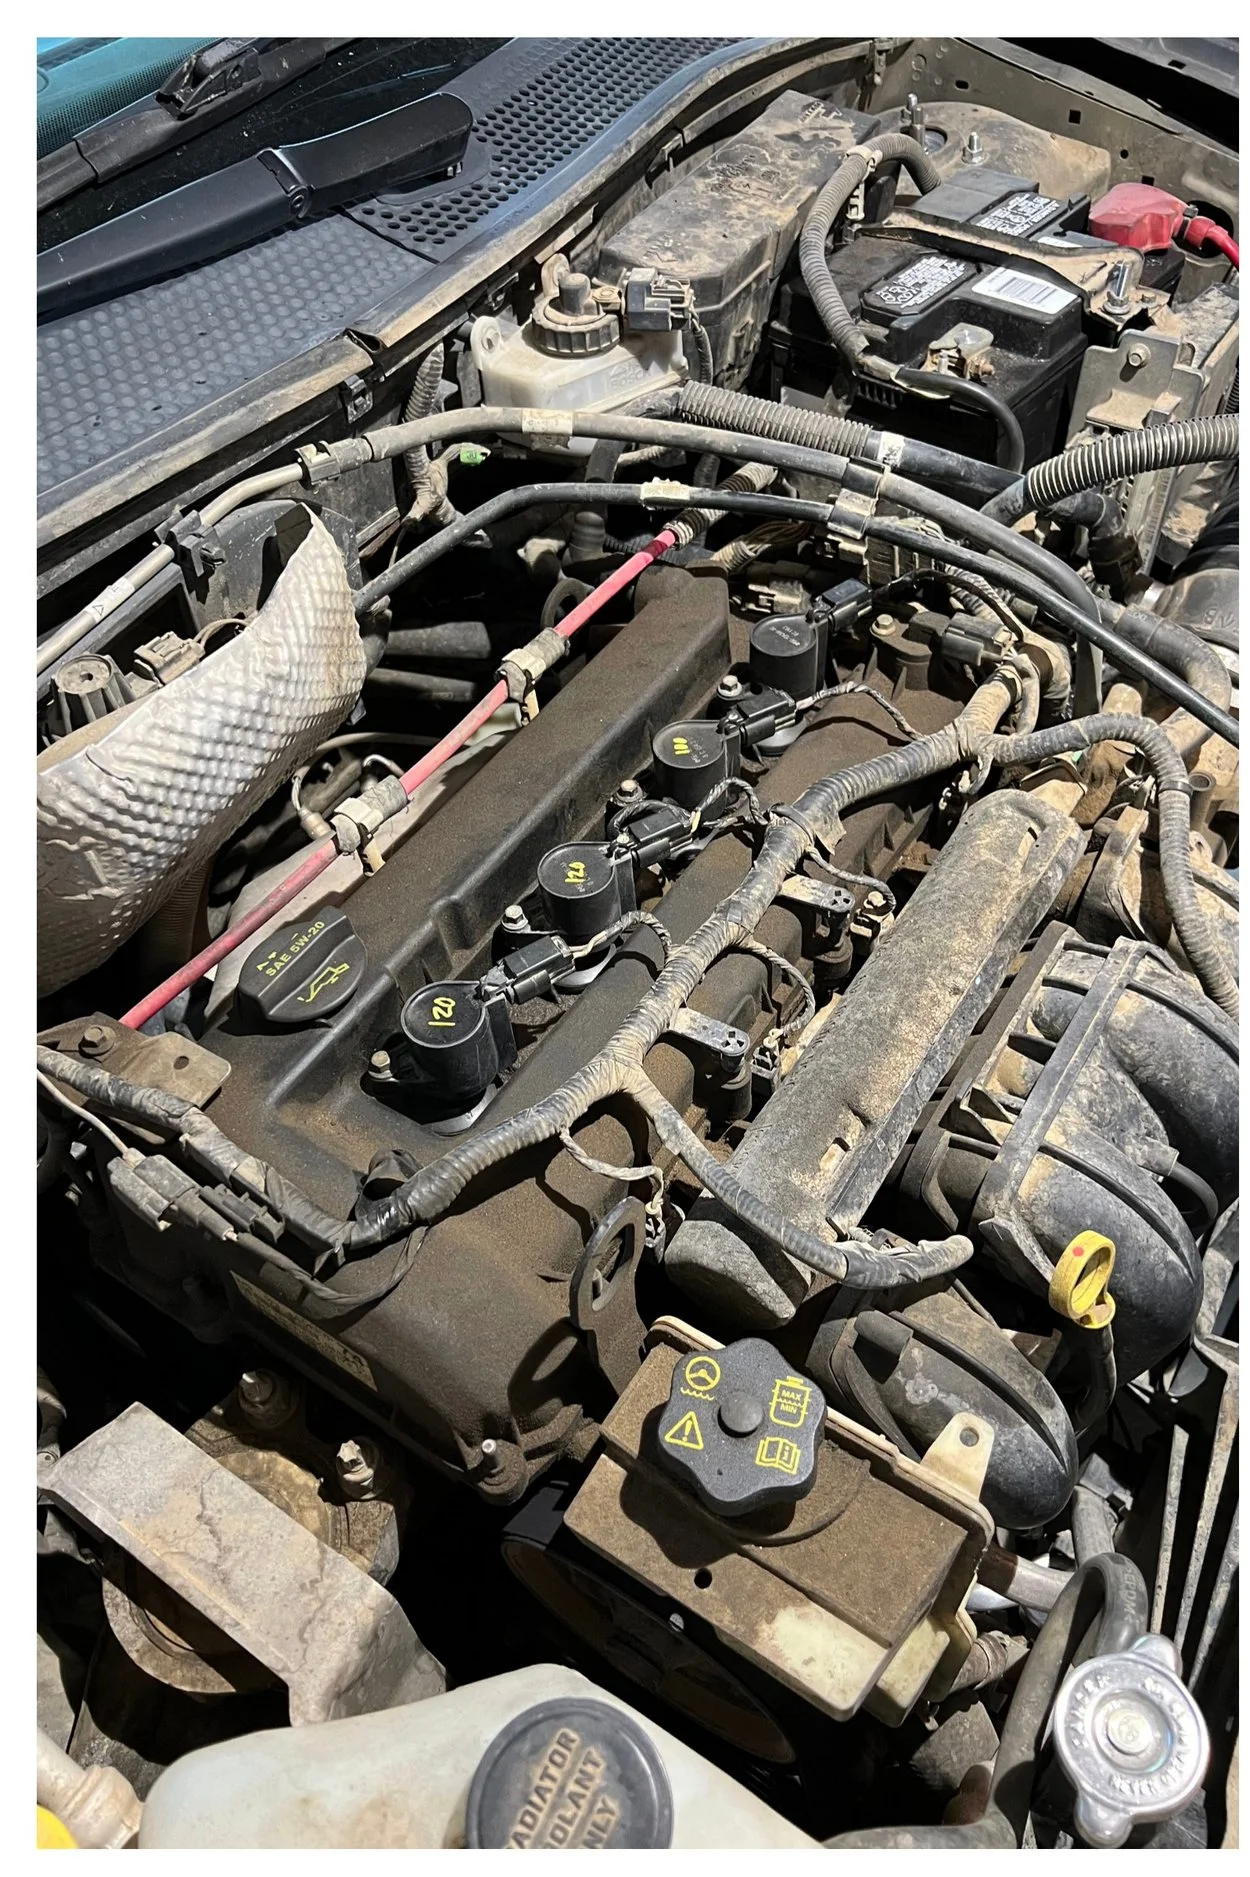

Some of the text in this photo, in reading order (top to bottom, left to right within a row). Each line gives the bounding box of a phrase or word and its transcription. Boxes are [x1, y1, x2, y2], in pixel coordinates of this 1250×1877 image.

[564, 861, 586, 883] 120
[266, 921, 325, 977] SAE 5W-20
[427, 996, 456, 1027] 120
[780, 1403, 798, 1414] MIN
[781, 1389, 802, 1401] MAX
[504, 1730, 577, 1849] ADIATOR
[580, 1796, 617, 1849] NLY
